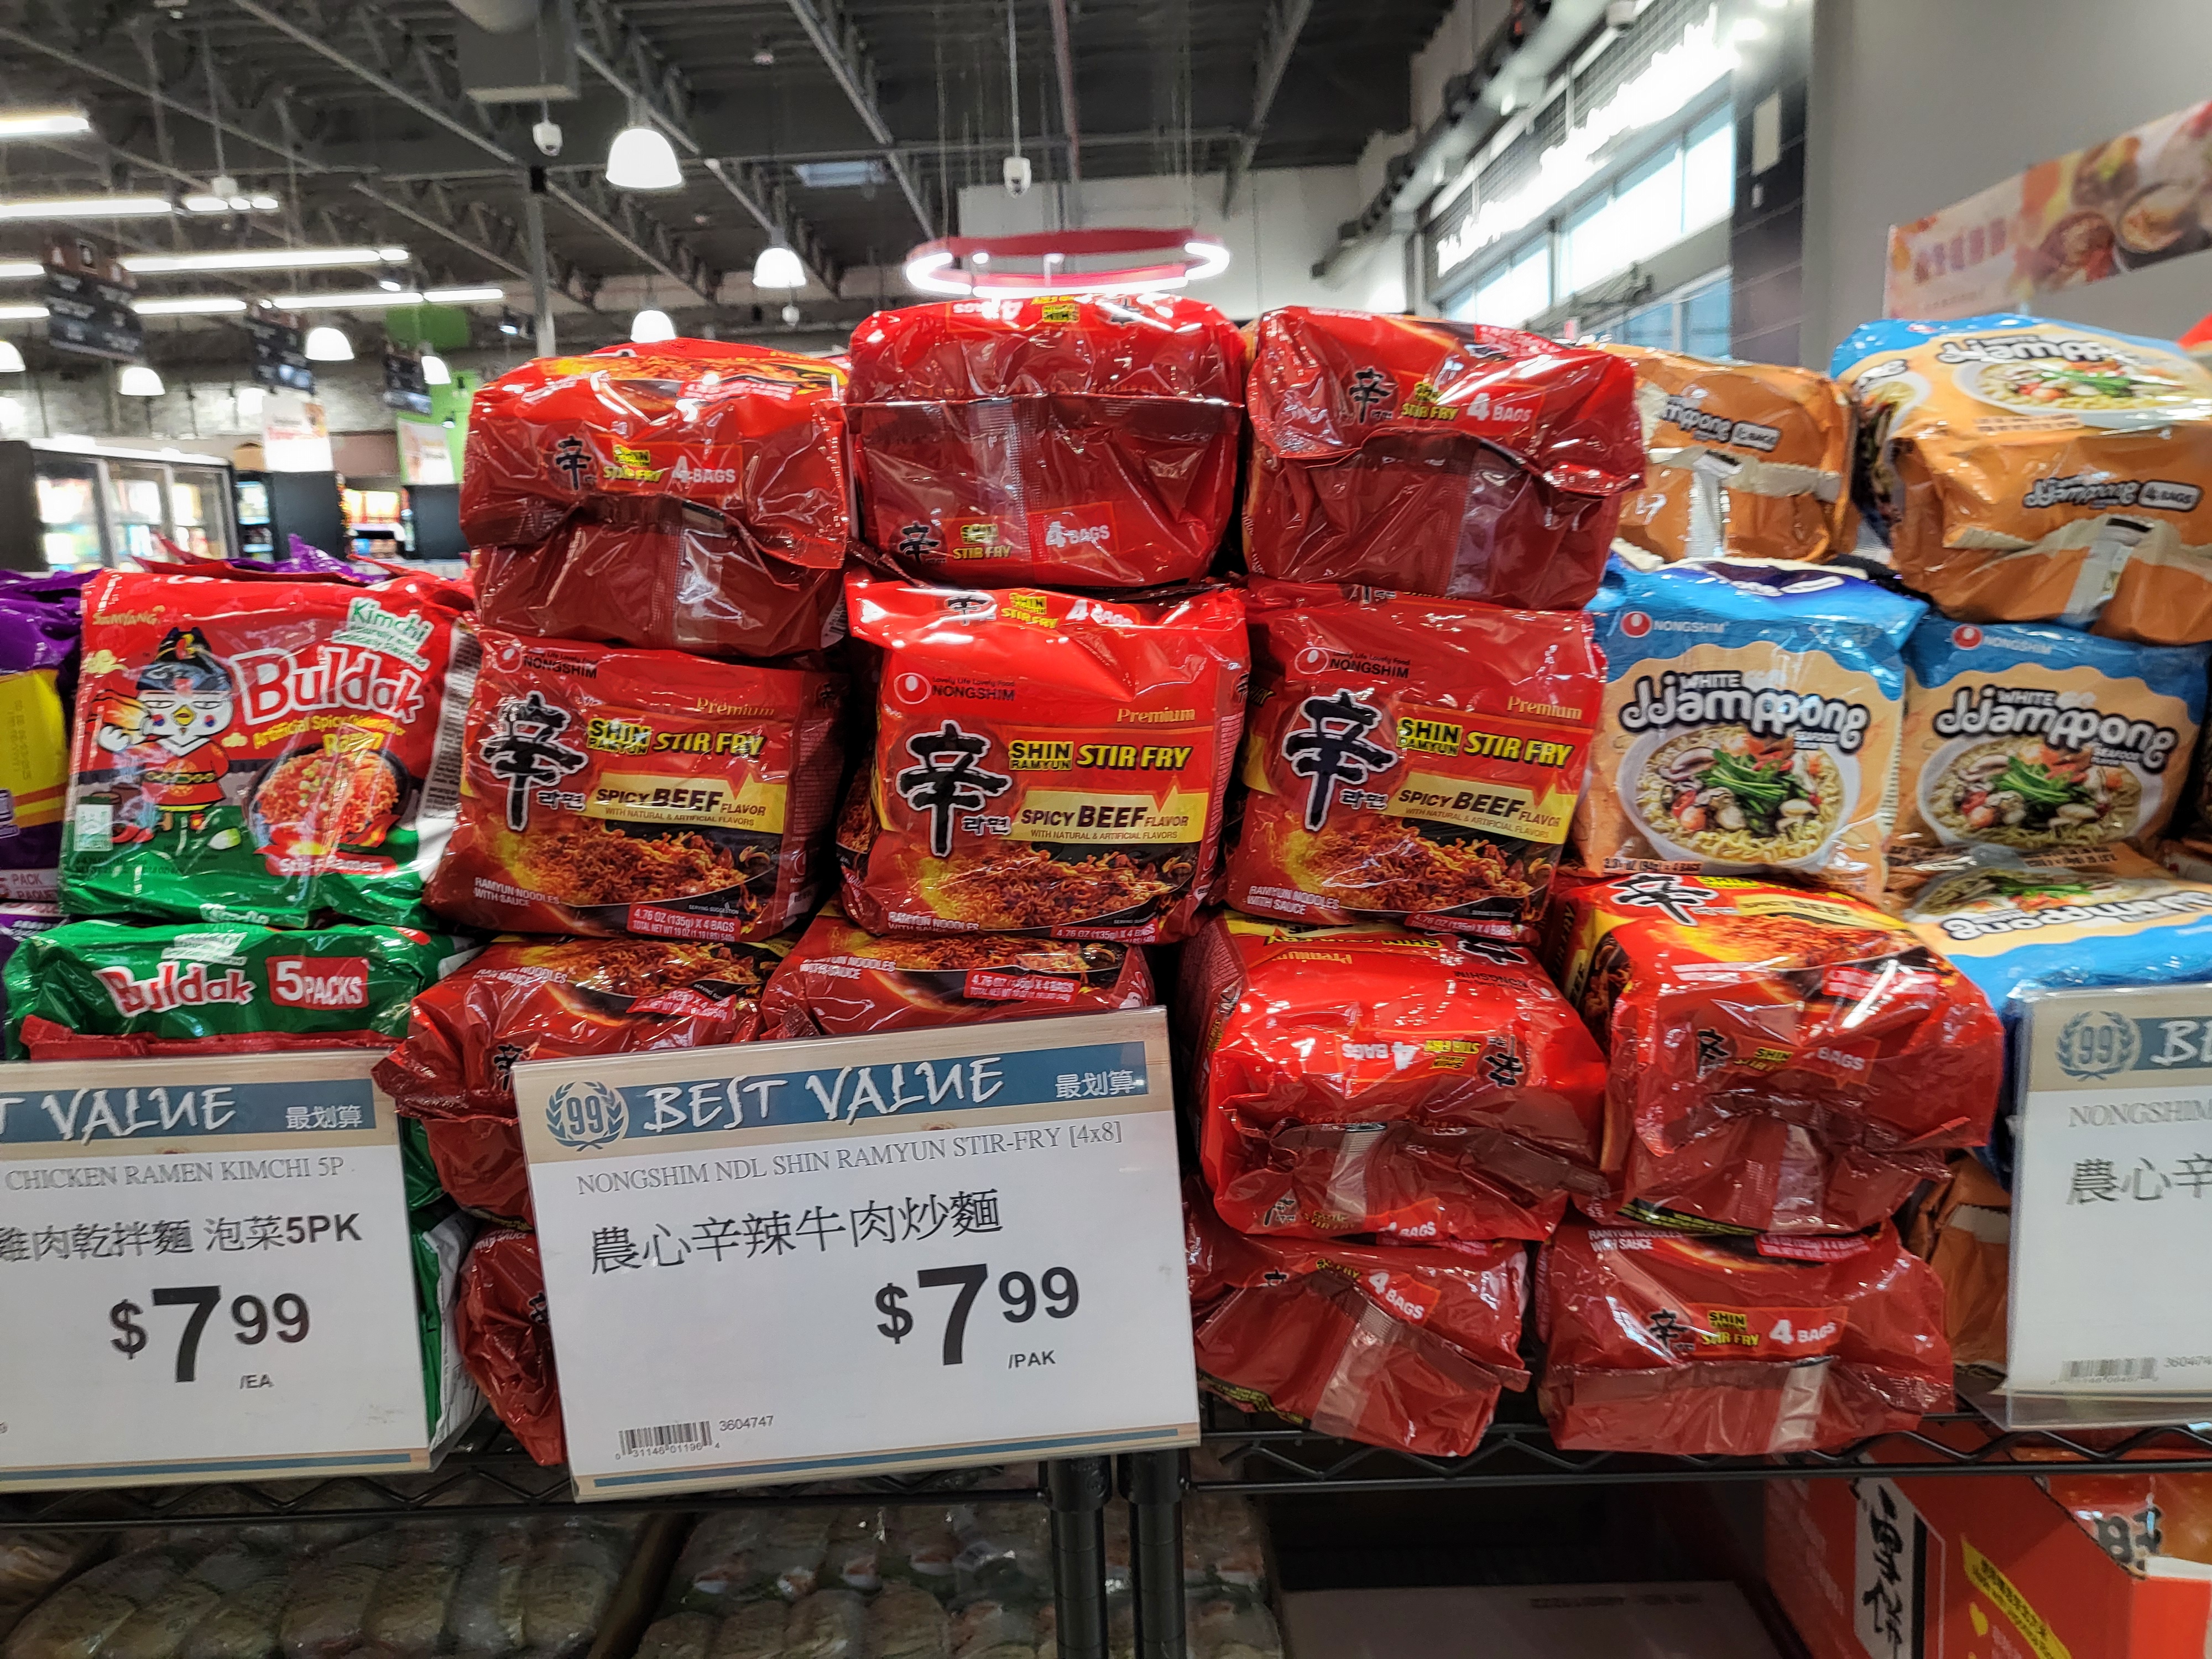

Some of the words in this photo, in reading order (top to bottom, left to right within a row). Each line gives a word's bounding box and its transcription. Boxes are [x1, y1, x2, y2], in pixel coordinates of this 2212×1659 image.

[1468, 393, 1490, 421] 4
[1494, 406, 1535, 422] BAGS
[672, 455, 690, 483] 4
[692, 468, 735, 483] BAGS
[1046, 521, 1066, 547] 4
[1069, 525, 1110, 544] BAGS
[351, 599, 431, 641] Kimchi
[1066, 599, 1089, 622] 4
[523, 655, 598, 679] NONGSHIM
[1329, 658, 1410, 679] NONGSHIM
[229, 647, 425, 726] Buldak
[1680, 671, 1742, 690] WHITE
[932, 685, 1016, 701] NONGSHIM
[1997, 689, 2058, 707] WHITE
[696, 697, 775, 716] Premium
[1116, 707, 1196, 724] Premium
[1507, 696, 1583, 720] Premium
[1398, 717, 1463, 745] SHIN
[653, 732, 712, 752] STIR
[716, 733, 766, 757] FRY
[1009, 739, 1074, 760] SHIN
[1076, 744, 1137, 769] STIR
[1140, 746, 1193, 769] FRY
[1464, 731, 1524, 761] STIR
[1523, 739, 1575, 769] FRY
[479, 690, 589, 832] 辛
[1009, 759, 1072, 771] RAMYUN
[1281, 687, 1400, 832] 辛
[896, 718, 1013, 858] 辛
[1339, 788, 1389, 811] 라면
[596, 787, 650, 803] SPICY
[652, 787, 723, 812] BEEF
[720, 803, 766, 816] FLAVOR
[1397, 789, 1454, 808] SPICY
[1451, 791, 1525, 818] BEEF
[606, 807, 626, 816] WITH
[627, 810, 664, 820] NATURAL
[674, 814, 717, 823] ARTIFICIAL
[718, 816, 755, 826] FLAVORS
[960, 814, 1012, 836] 라면
[1021, 808, 1075, 827] SPICY
[1077, 805, 1149, 828] BEEF
[1144, 815, 1189, 828] FLAVOR
[1406, 807, 1426, 816] WITH
[1427, 809, 1463, 822] NATURAL
[1470, 816, 1512, 832] ARTIFICIAL
[1031, 829, 1051, 838] WITH
[1052, 830, 1091, 839] NATURAL
[1093, 831, 1098, 839] &
[1099, 831, 1141, 840] ARTIFICIAL
[1142, 830, 1178, 839] FLAVORS
[11, 873, 43, 885] PACK
[474, 877, 516, 896] RAMYUN
[516, 887, 560, 905] NOODLES
[474, 887, 498, 902] WITH
[499, 893, 531, 907] SAUCE
[1272, 899, 1306, 916] SAUCE
[1293, 891, 1340, 911] NOODLES
[1608, 873, 1719, 926] 辛
[634, 907, 653, 922] 4.76
[654, 911, 666, 924] OZ
[695, 918, 703, 929] X
[704, 919, 711, 930] 4
[711, 920, 735, 933] BAGS
[888, 921, 914, 930] WITH
[1056, 929, 1076, 938] 4.76
[1126, 929, 1133, 937] 4
[92, 961, 257, 1017] Buldak
[1342, 1042, 1389, 1060] BAGS
[1391, 1042, 1420, 1071] 4
[1754, 1046, 1793, 1061] SHIN
[2080, 1026, 2113, 1065] 99
[1817, 1047, 1865, 1071] BAGS
[566, 1095, 601, 1135] 99
[643, 1074, 788, 1133] BEST
[805, 1056, 1005, 1126] VALUE
[1055, 1069, 1134, 1099] 最划算
[41, 1086, 237, 1145] VALUE
[285, 1105, 363, 1130] 最划算
[576, 1162, 709, 1195] NONGSHIM
[716, 1159, 768, 1181] NDL
[773, 1150, 830, 1176] SHIN
[836, 1138, 946, 1169] RAMYUN
[953, 1126, 1062, 1158] STIR-FRY
[1069, 1121, 1123, 1149] [4x8]
[6, 1165, 117, 1192] CHICKEN
[124, 1161, 214, 1186] RAMEN
[221, 1157, 311, 1182] KIMCHI
[317, 1155, 345, 1178] 5P
[591, 1187, 1003, 1275] 農心辛辣牛肉炒麵
[1400, 1221, 1436, 1237] BAGS
[1619, 1239, 1653, 1251] SAUCE
[1368, 1271, 1390, 1295] 4
[1385, 1287, 1424, 1320] BAGS
[1708, 1311, 1746, 1325] SHIN
[1733, 1333, 1760, 1347] FRY
[1769, 1319, 1794, 1345] 4
[1797, 1322, 1838, 1343] BAGS
[1008, 1349, 1056, 1369] /PAK
[239, 1374, 275, 1390] /EA
[718, 1415, 774, 1432] 3604747
